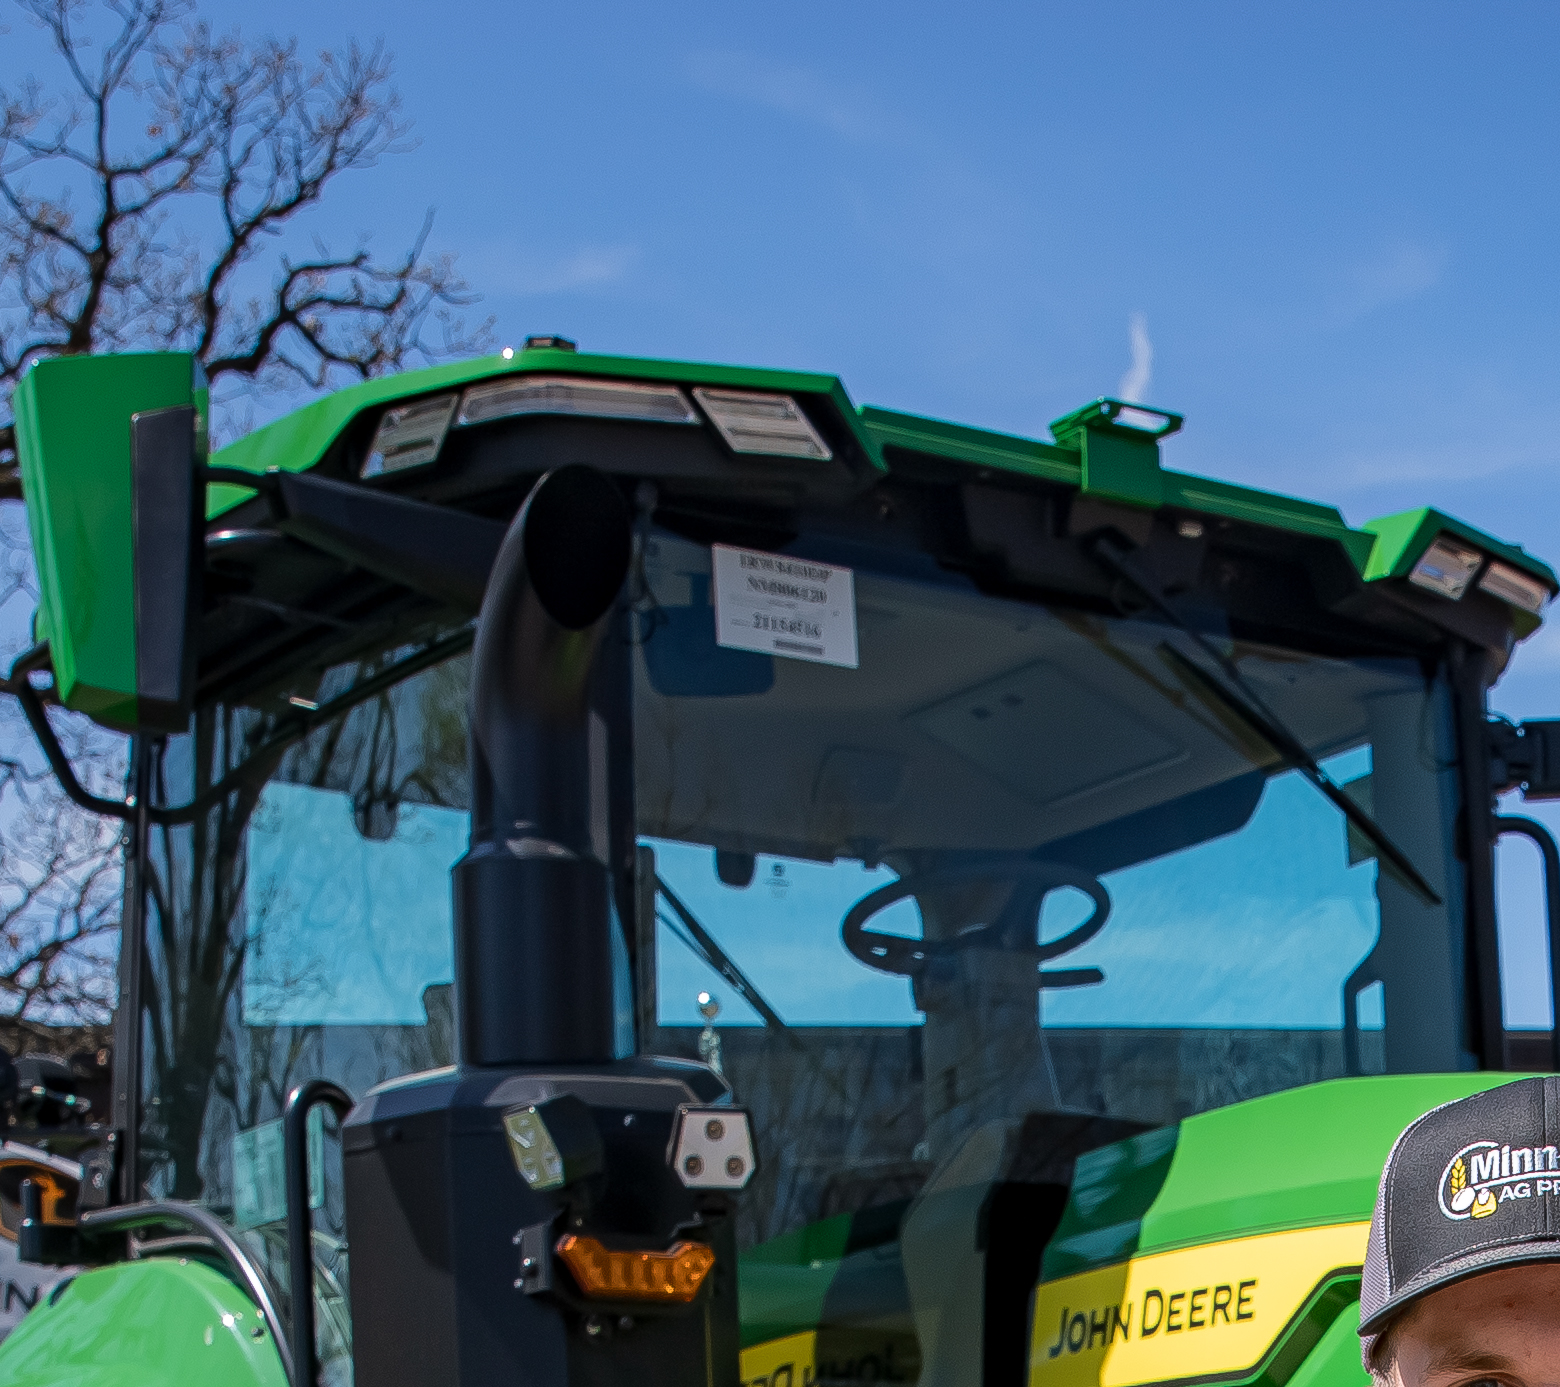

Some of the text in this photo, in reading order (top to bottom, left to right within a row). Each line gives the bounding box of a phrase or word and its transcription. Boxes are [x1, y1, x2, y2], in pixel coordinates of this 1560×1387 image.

[1498, 1183, 1532, 1204] AG
[1049, 1279, 1258, 1359] JOHN DEERE
